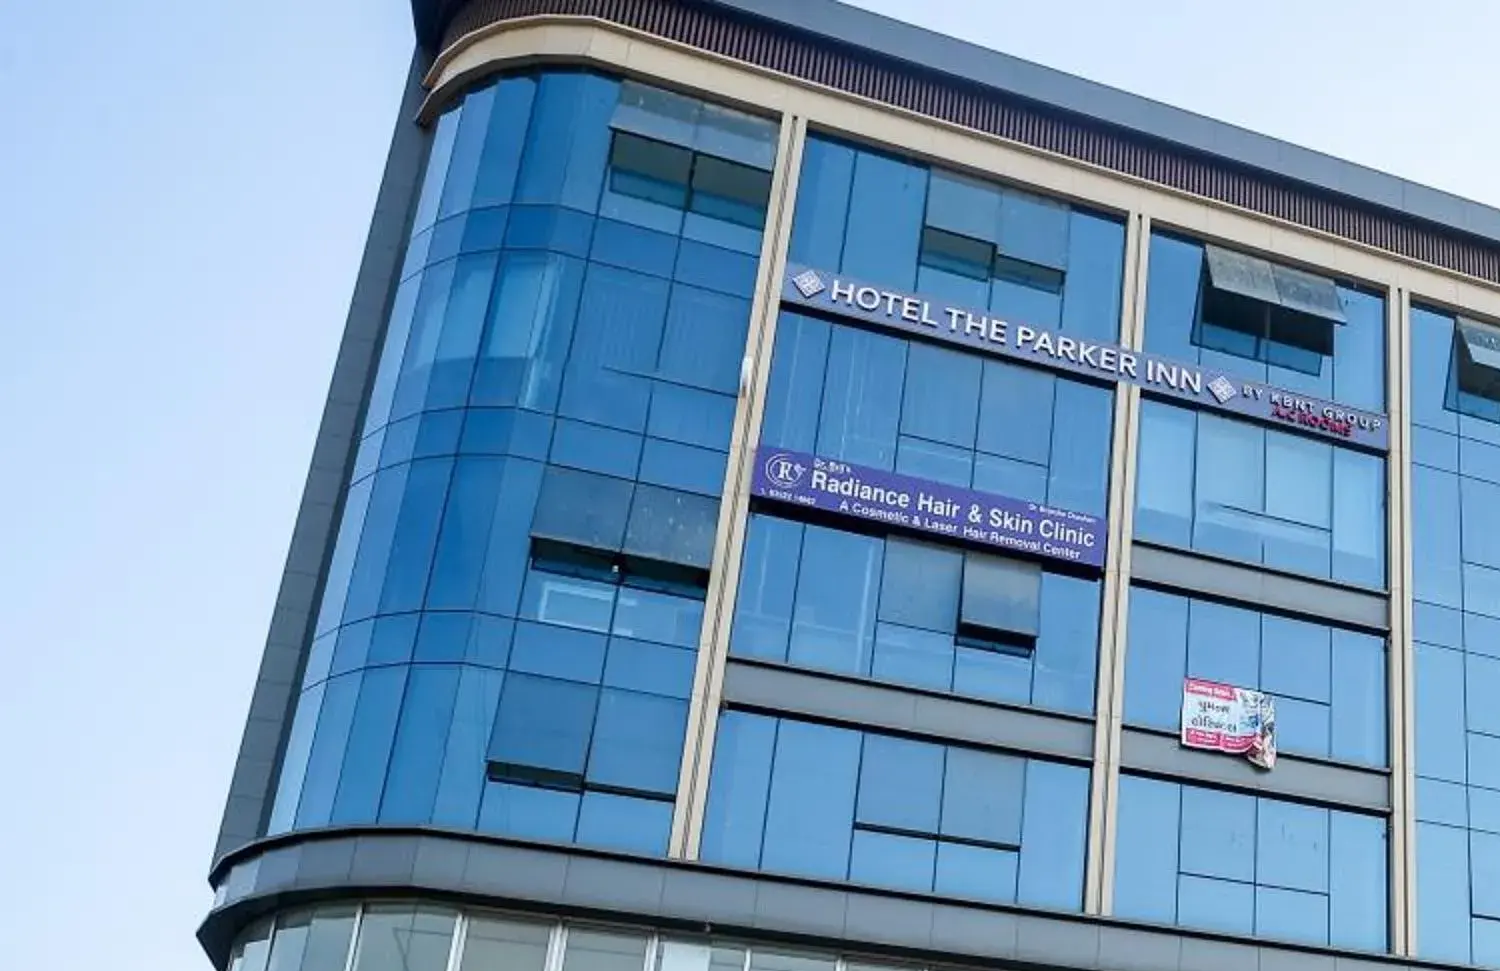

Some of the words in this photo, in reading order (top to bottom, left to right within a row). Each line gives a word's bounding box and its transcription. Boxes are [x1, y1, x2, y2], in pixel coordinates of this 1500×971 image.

[830, 279, 939, 328] HOTEL
[945, 306, 1007, 343] THE
[1015, 325, 1137, 379] PARKER
[1146, 359, 1201, 394] INN
[1243, 384, 1263, 400] BY
[1322, 406, 1381, 431] GROUP
[811, 470, 910, 507] Radiance
[917, 492, 961, 518] Hair
[968, 504, 982, 524] &
[989, 509, 1032, 534] Skin
[1039, 520, 1094, 547] Clinic
[839, 501, 849, 511] A
[853, 502, 909, 523] Cosmetic
[912, 516, 920, 527] &
[925, 519, 957, 533] Laser
[963, 526, 987, 539] Hair
[989, 531, 1040, 550] Removal
[1043, 543, 1081, 559] Center
